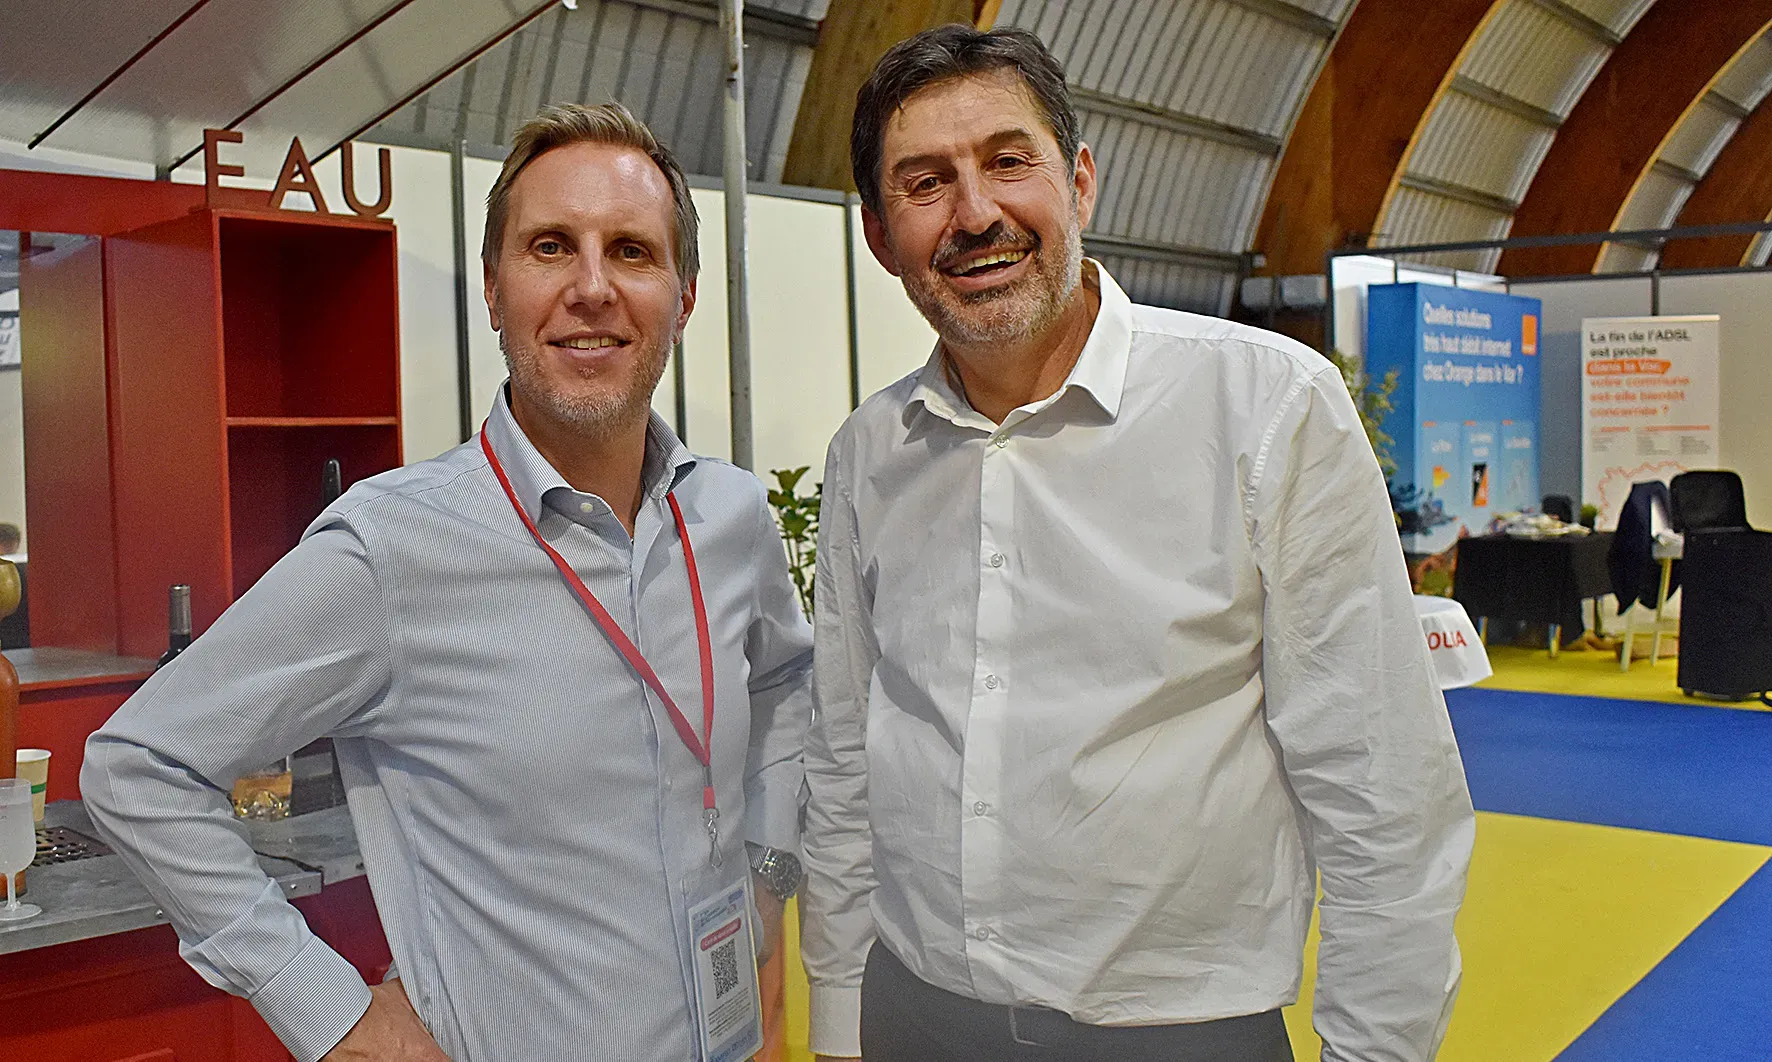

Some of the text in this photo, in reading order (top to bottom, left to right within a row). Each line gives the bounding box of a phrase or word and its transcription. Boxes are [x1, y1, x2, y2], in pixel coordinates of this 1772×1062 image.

[204, 128, 391, 217] EAU
[1423, 302, 1492, 330] Quelles solutions
[1440, 332, 1460, 354] haut
[1481, 337, 1512, 358] internet
[1590, 331, 1606, 342] La
[1609, 331, 1625, 341] fin
[1628, 330, 1644, 341] de
[1590, 346, 1657, 358] est proche
[1423, 360, 1443, 381] chez
[1444, 360, 1475, 387] Orange
[1476, 362, 1494, 383] dans
[1590, 361, 1621, 373] dans
[1590, 377, 1690, 387] votre commune
[1427, 630, 1468, 650] OLIA
